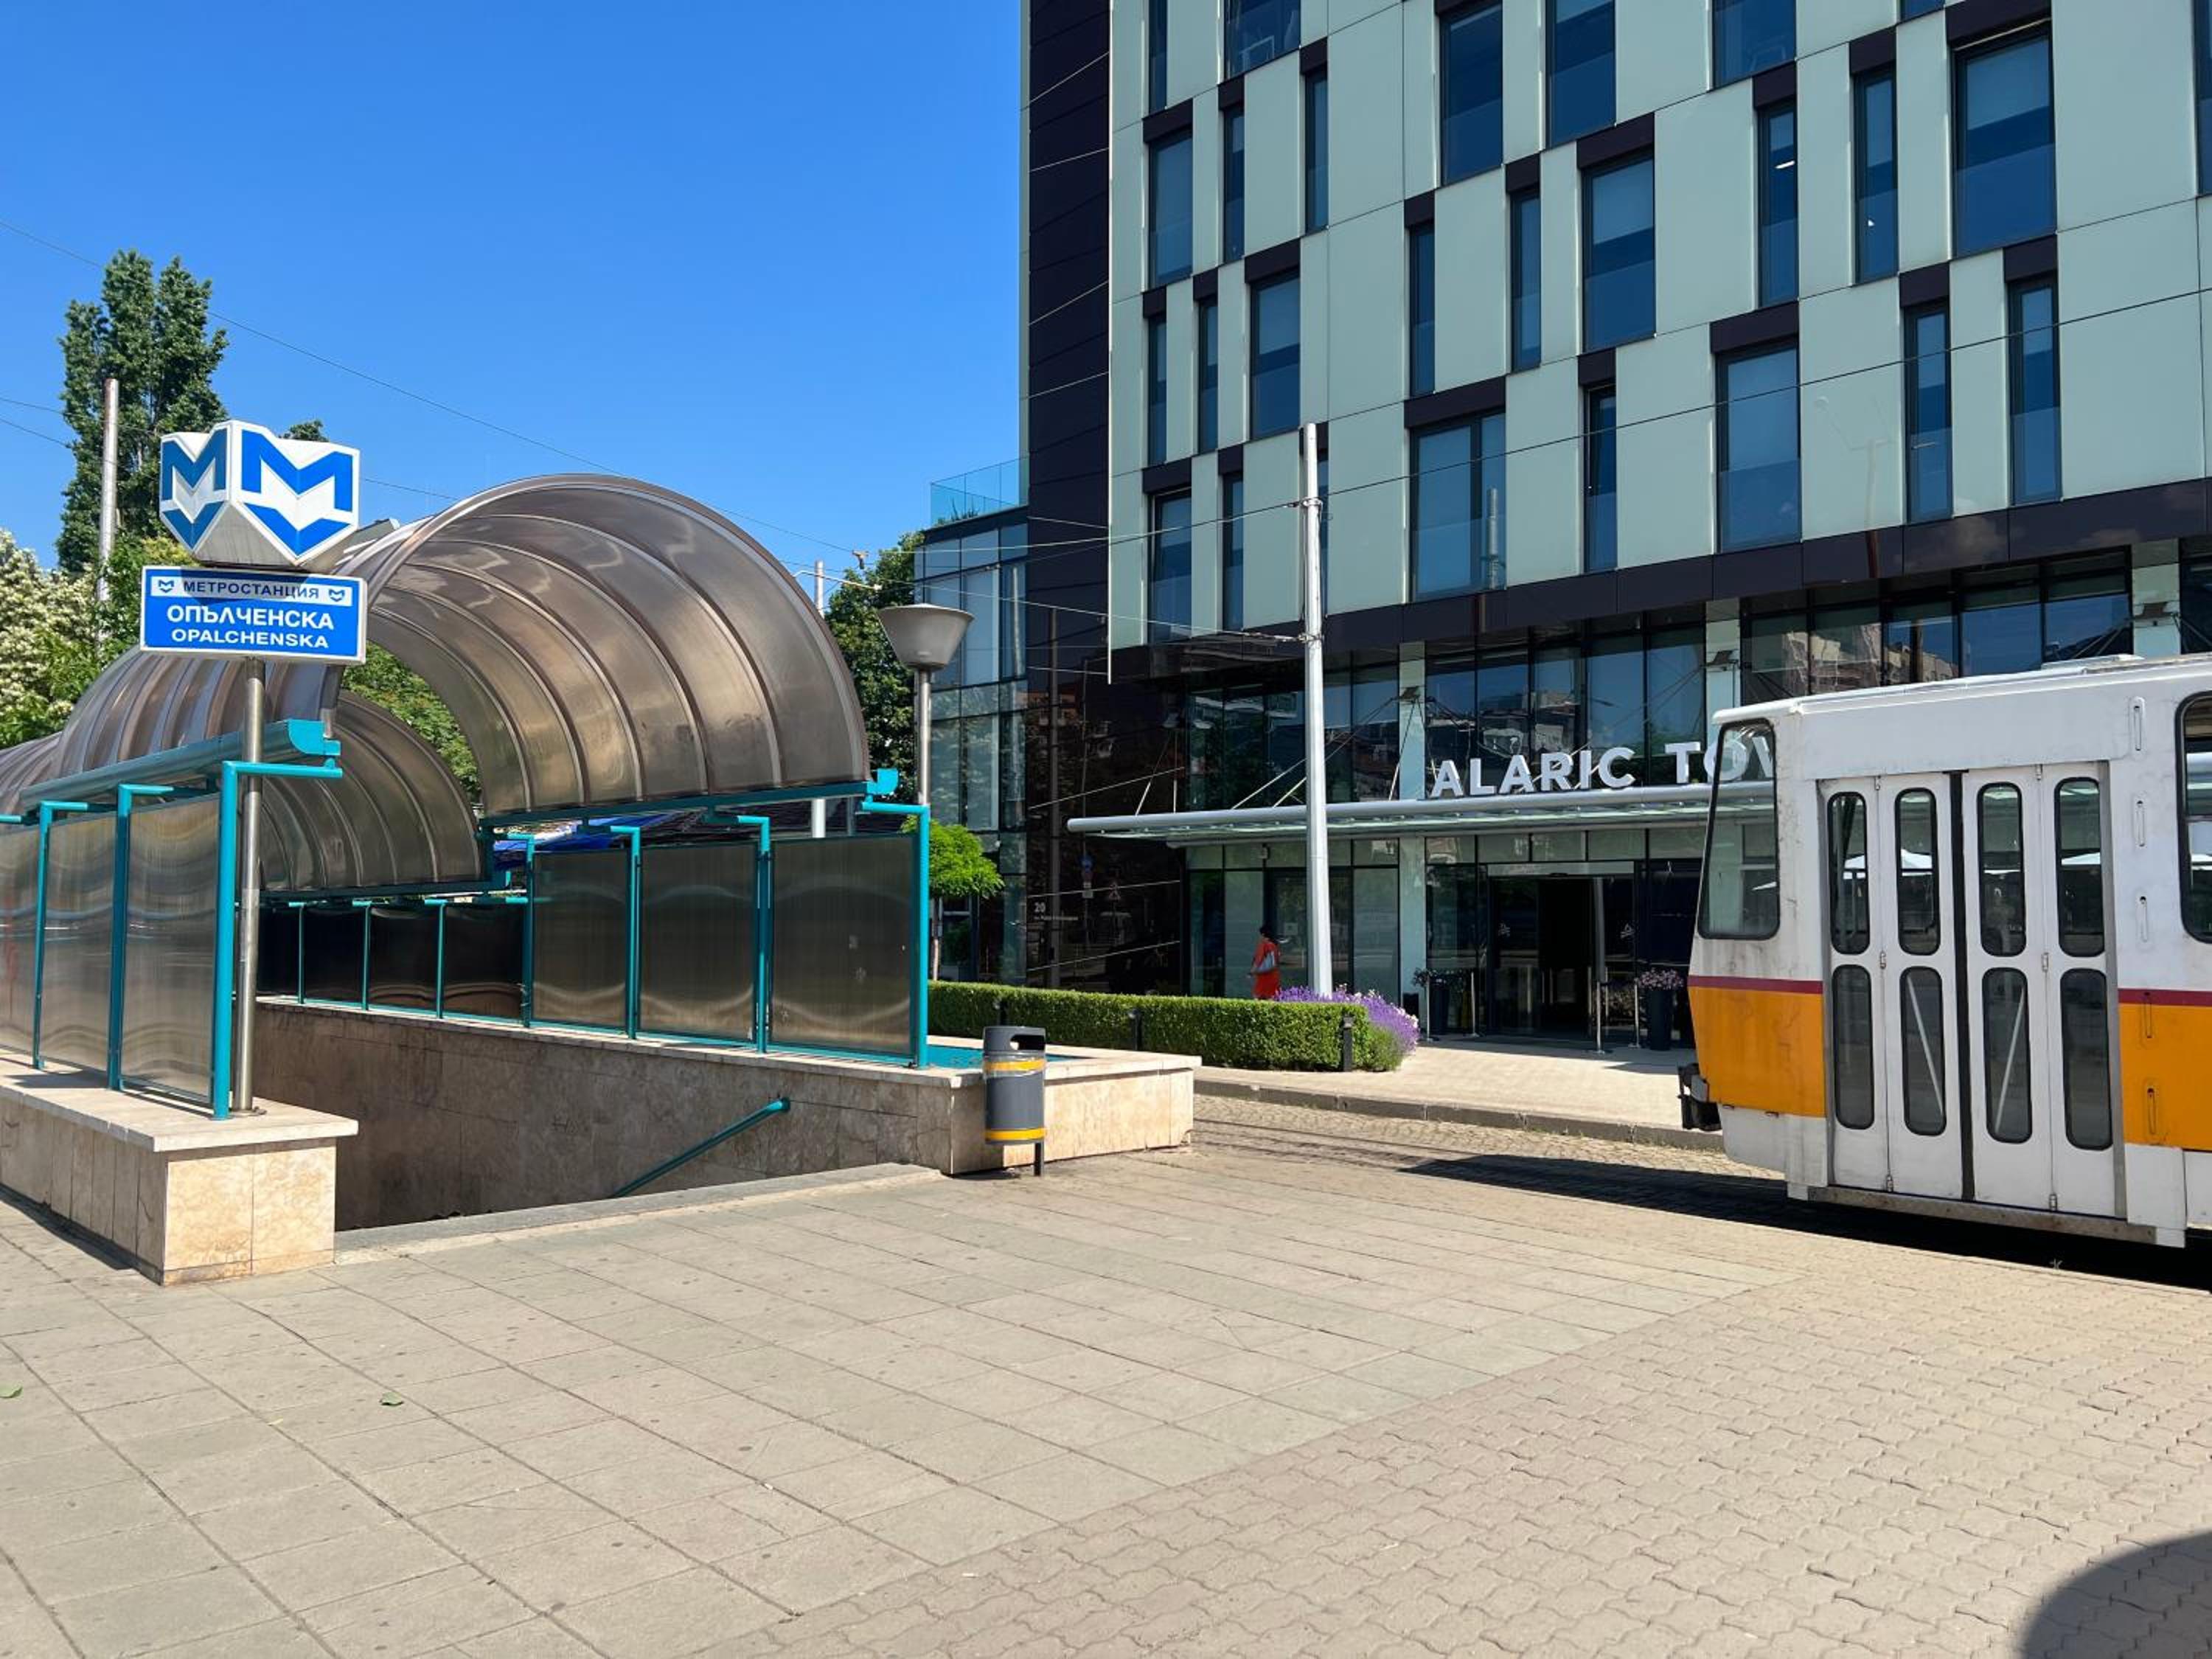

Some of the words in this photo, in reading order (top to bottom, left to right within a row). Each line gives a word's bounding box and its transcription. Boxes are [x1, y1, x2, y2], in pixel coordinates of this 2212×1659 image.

[183, 581, 319, 599] МЕТРОСТАНЦИЯ
[167, 605, 334, 630] ОПЪЛЧЕНСКА
[171, 629, 329, 648] OPALCHENSKA
[1430, 746, 1635, 799] ALARIC
